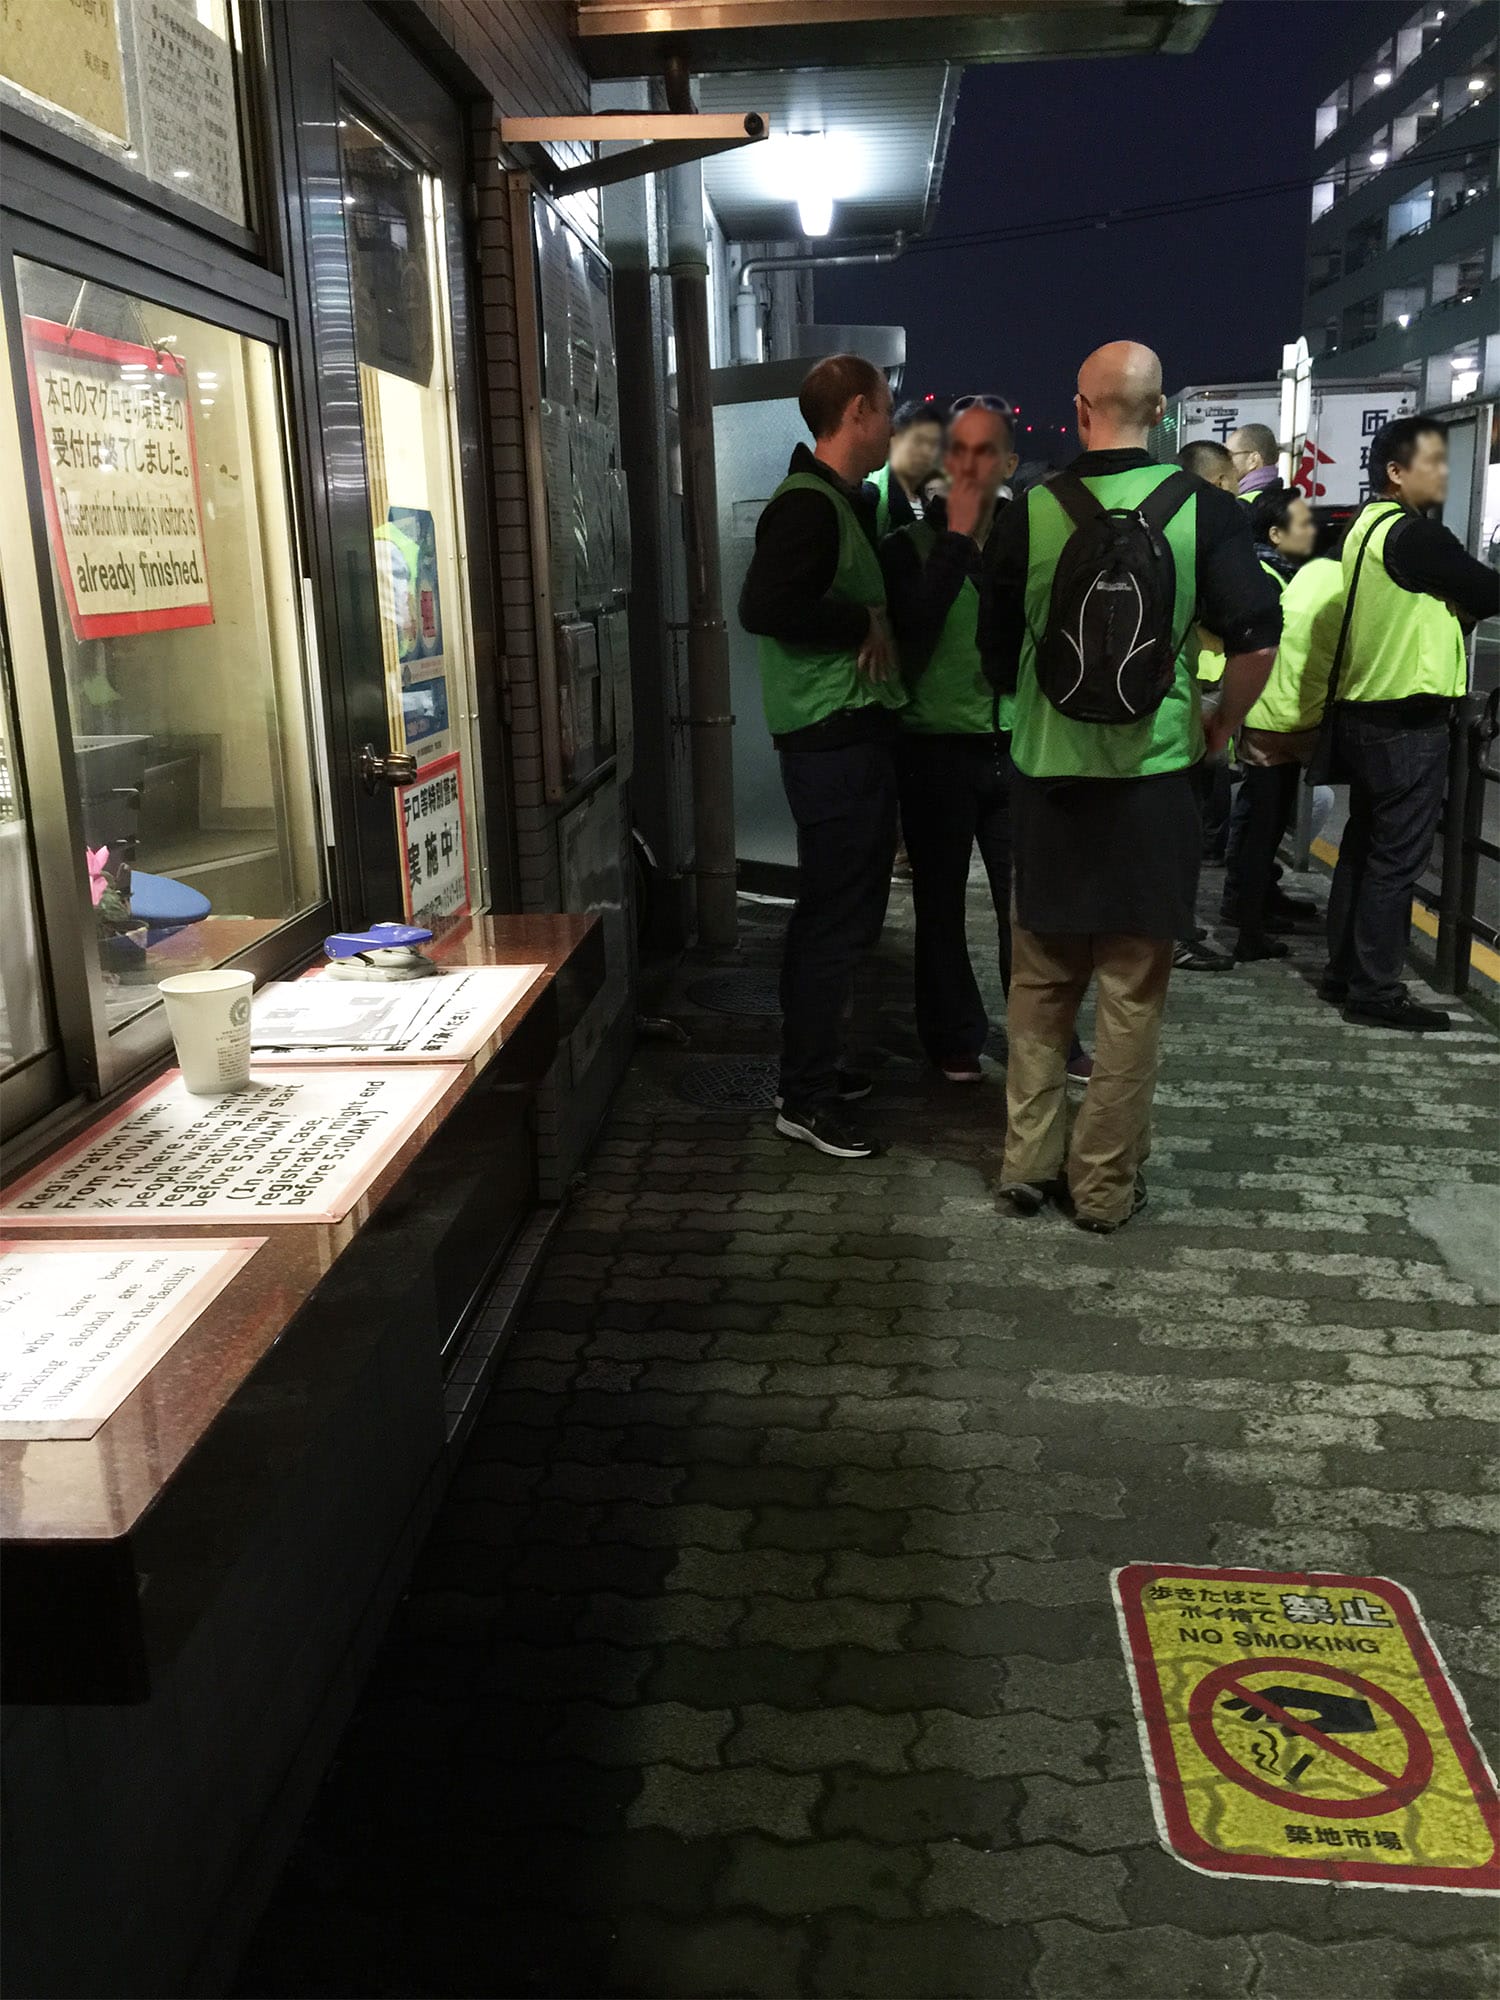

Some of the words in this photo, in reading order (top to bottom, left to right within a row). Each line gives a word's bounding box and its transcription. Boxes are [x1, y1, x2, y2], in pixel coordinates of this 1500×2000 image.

[52, 426, 190, 477] 受付は終了しました。
[77, 551, 137, 596] already
[139, 549, 204, 588] finished.
[17, 1134, 131, 1209] Registration
[119, 1103, 172, 1132] Time:
[112, 1177, 142, 1189] If
[133, 1143, 180, 1174] there
[178, 1122, 210, 1145] are
[205, 1092, 248, 1118] many
[126, 1165, 187, 1208] people
[179, 1118, 242, 1162] waiting
[226, 1108, 248, 1117] in
[241, 1084, 283, 1104] line,
[156, 1135, 248, 1208] registration
[242, 1110, 279, 1131] may
[269, 1084, 304, 1108] start
[226, 1178, 263, 1200] (In
[256, 1147, 296, 1175] such
[288, 1116, 330, 1143] case,
[255, 1134, 336, 1206] registration
[328, 1101, 368, 1130] might
[359, 1080, 386, 1098] end
[279, 1163, 337, 1206] before
[322, 1110, 389, 1161] 5:00AM.)
[53, 1174, 109, 1209] From
[181, 1165, 243, 1208] before
[0, 1360, 68, 1411] drinking
[69, 1310, 115, 1348] alcohol
[118, 1283, 143, 1300] are
[145, 1257, 169, 1273] not
[22, 1332, 55, 1355] who
[56, 1293, 97, 1317] have
[97, 1259, 135, 1280] been
[43, 1364, 97, 1409] allowed
[89, 1350, 111, 1364] to
[105, 1319, 141, 1349] enter
[131, 1301, 160, 1318] the
[148, 1265, 197, 1300] facility.
[1149, 1586, 1271, 1606] 歩きたばこ
[1279, 1592, 1395, 1628] 禁止
[1178, 1628, 1223, 1644] NO
[1233, 1631, 1381, 1654] SMOKING
[1180, 1605, 1277, 1624] ポイ捨て
[1284, 1825, 1404, 1851] 築地市場
